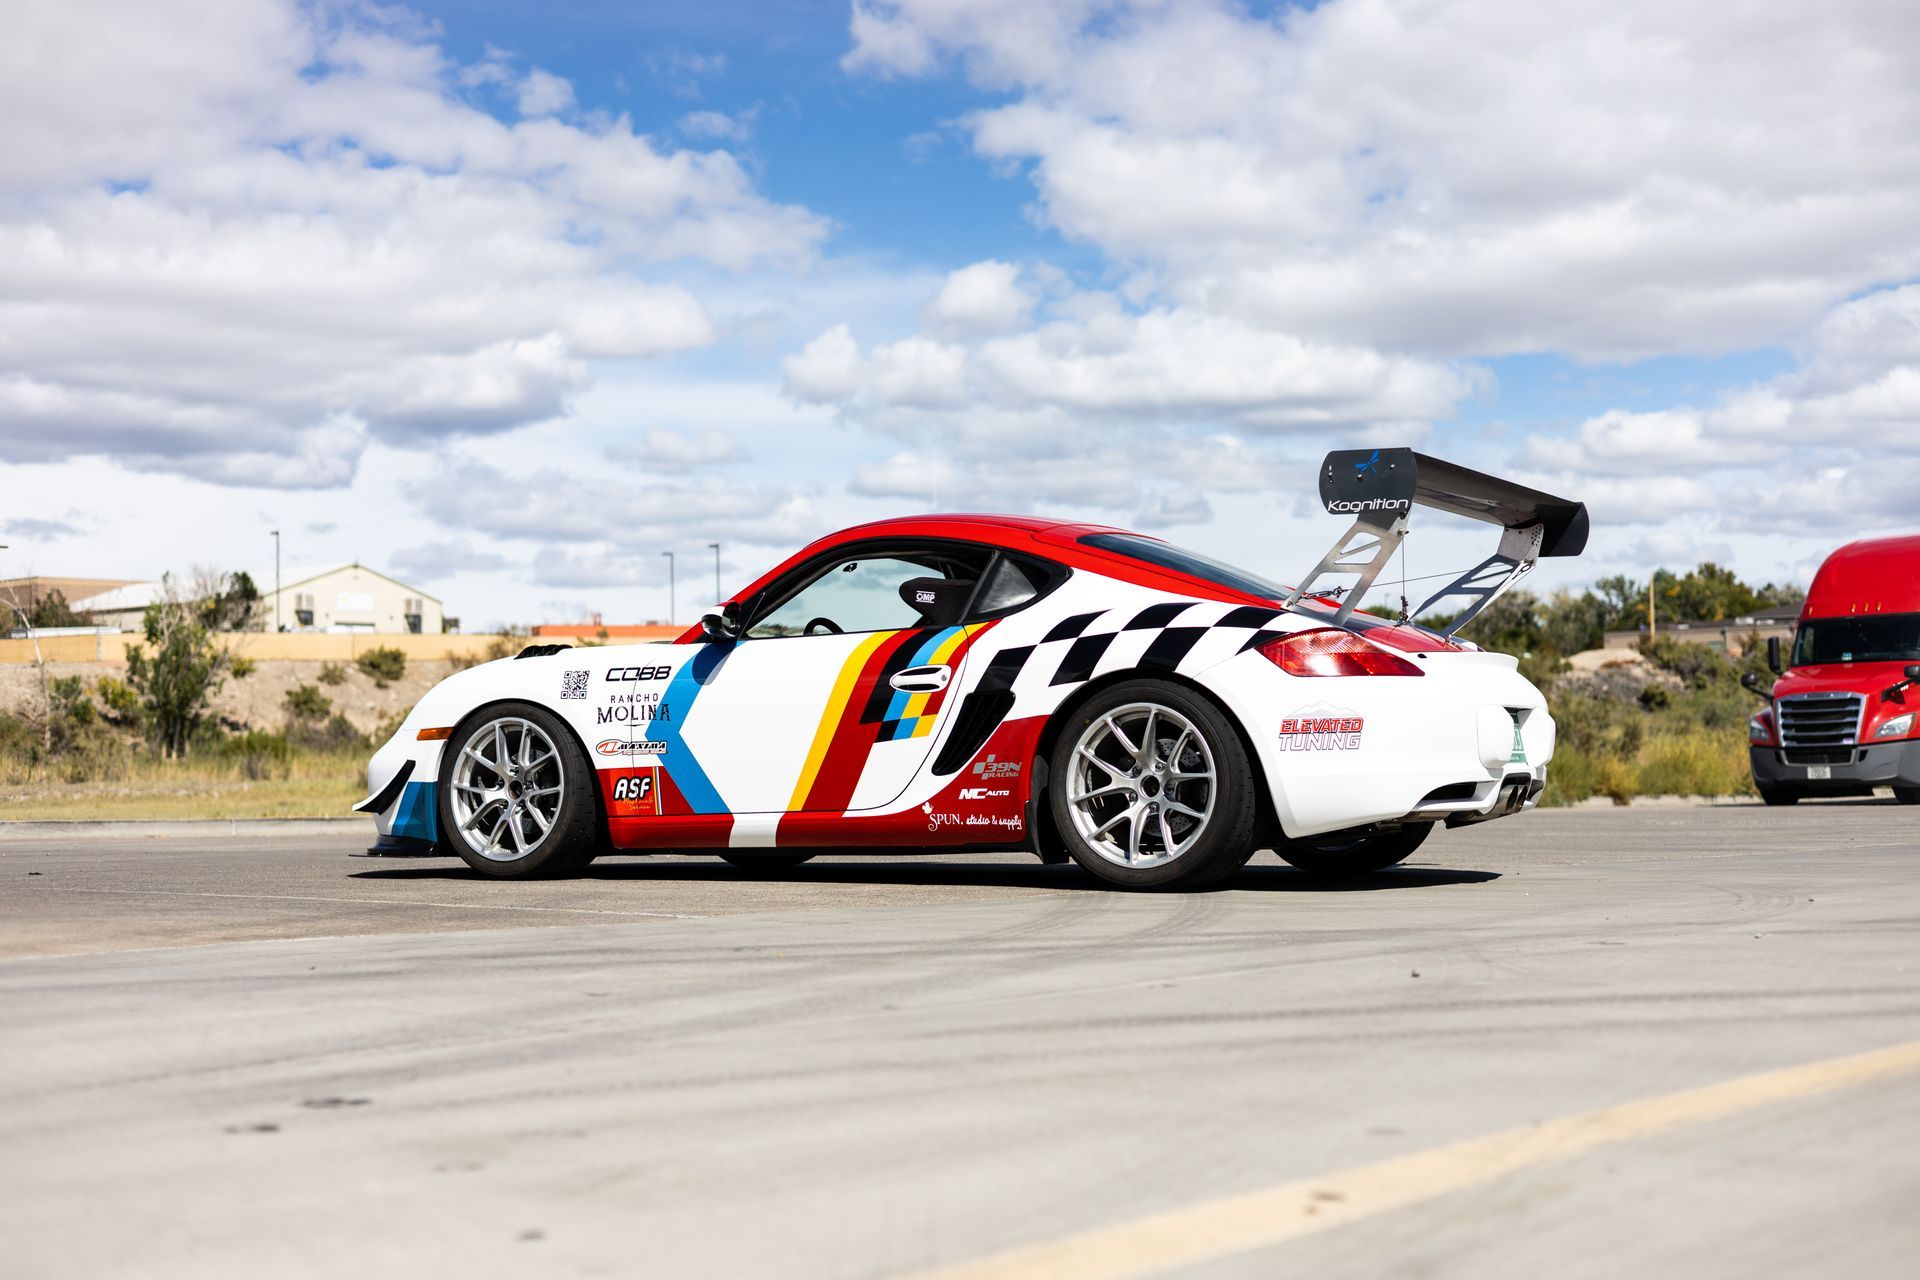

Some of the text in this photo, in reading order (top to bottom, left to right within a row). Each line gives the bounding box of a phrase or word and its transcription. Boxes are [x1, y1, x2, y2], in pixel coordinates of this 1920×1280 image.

[1328, 498, 1409, 513] Kognition
[916, 592, 935, 602] OMP
[605, 665, 672, 682] COBB
[610, 692, 659, 704] RANCHO
[597, 703, 671, 725] MOLINA
[1280, 717, 1364, 733] ELEVATED
[617, 742, 666, 750] MAXIMA
[1279, 732, 1362, 752] TUNING
[614, 777, 651, 800] ASF
[958, 788, 987, 800] NC
[927, 813, 1023, 832] SPUN. studio & supply
